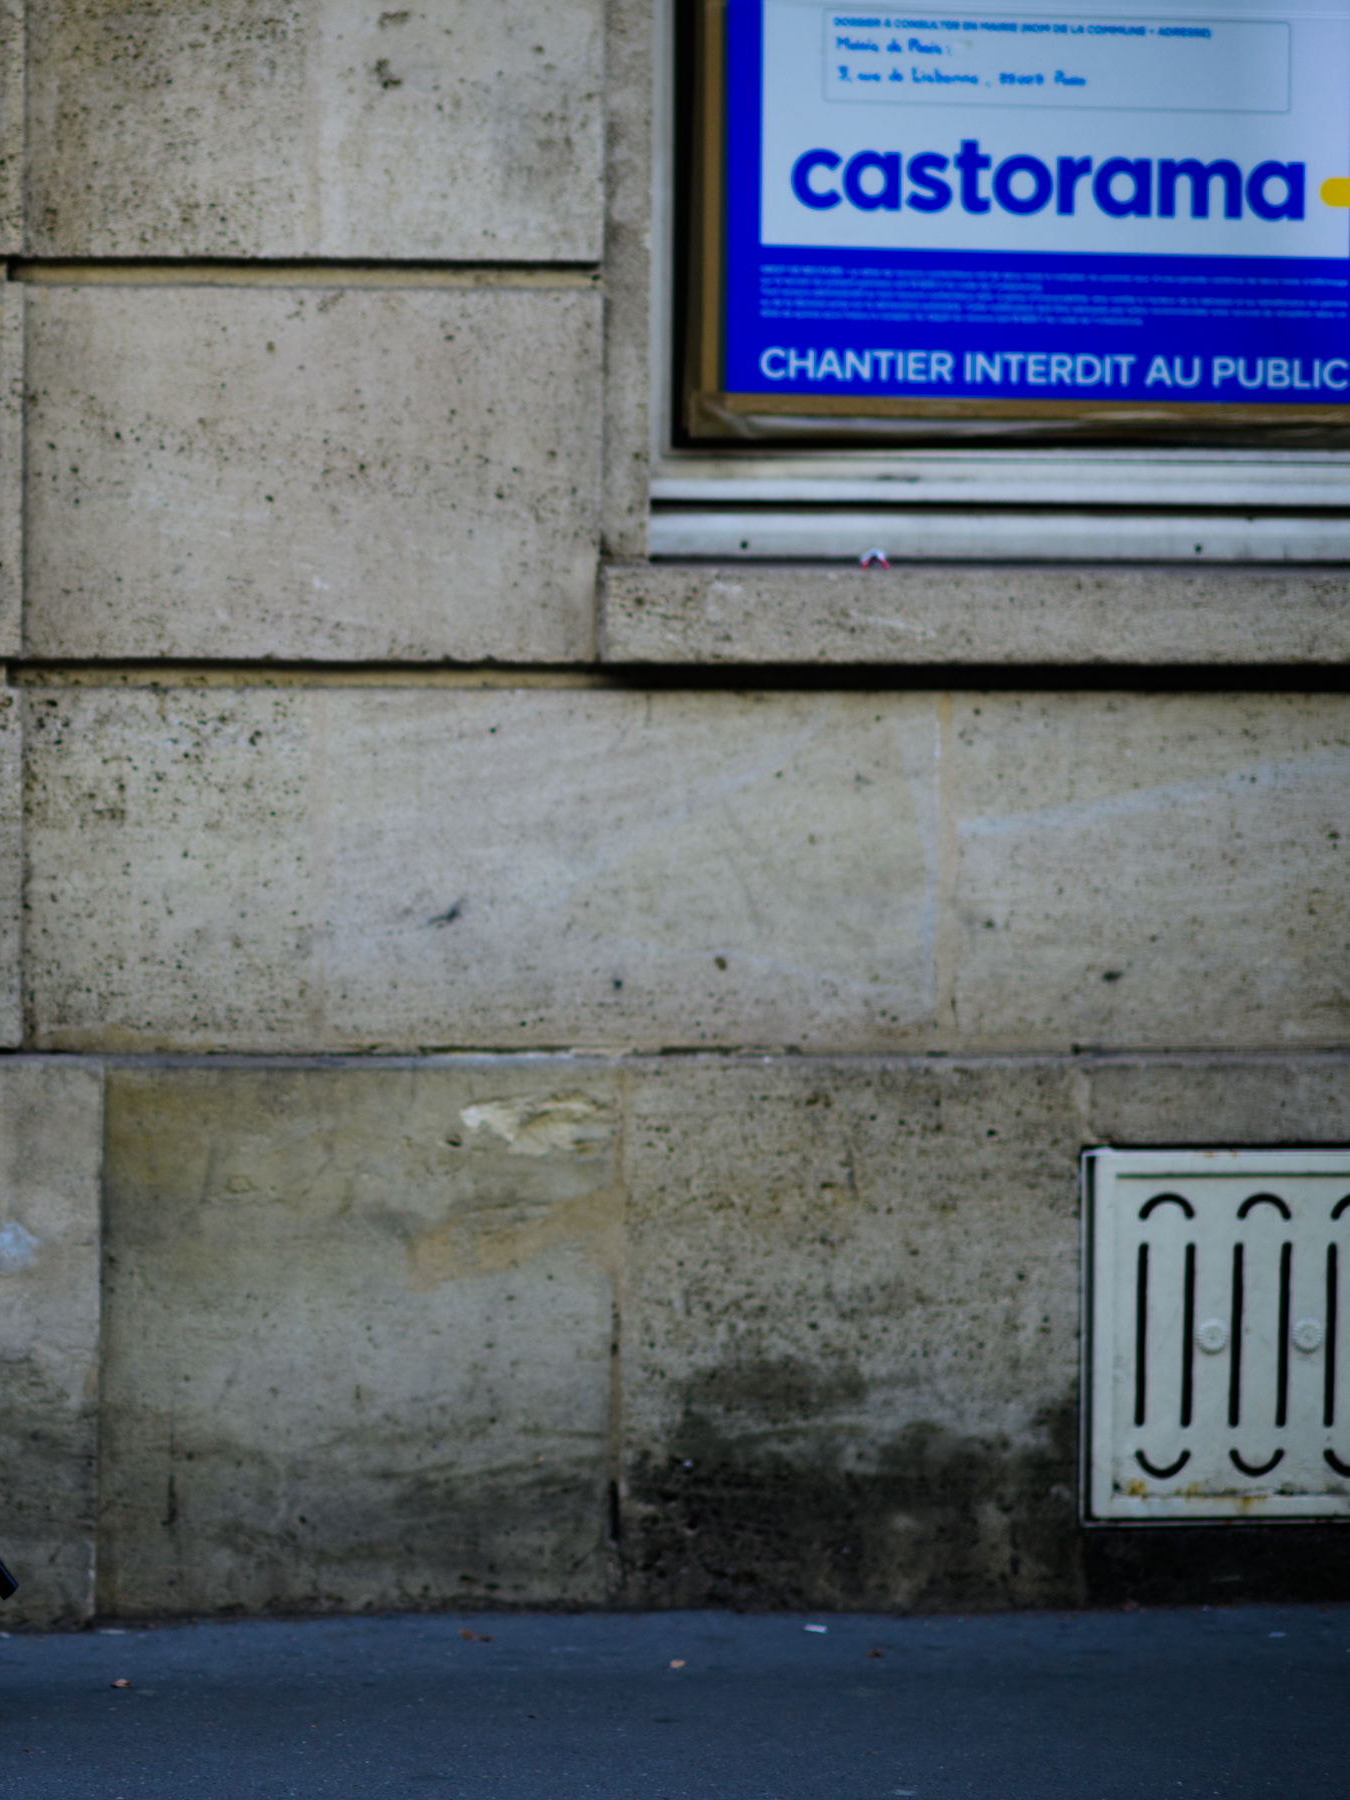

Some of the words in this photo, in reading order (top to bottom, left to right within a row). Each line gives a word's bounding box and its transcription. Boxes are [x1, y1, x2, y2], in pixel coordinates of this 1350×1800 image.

[1070, 25, 1085, 35] LA
[791, 139, 1307, 221] castorama
[759, 346, 955, 383] CHANTIER
[964, 351, 1135, 386] INTERDIT
[1145, 355, 1202, 387] AU
[1212, 356, 1350, 390] PUBLIC
